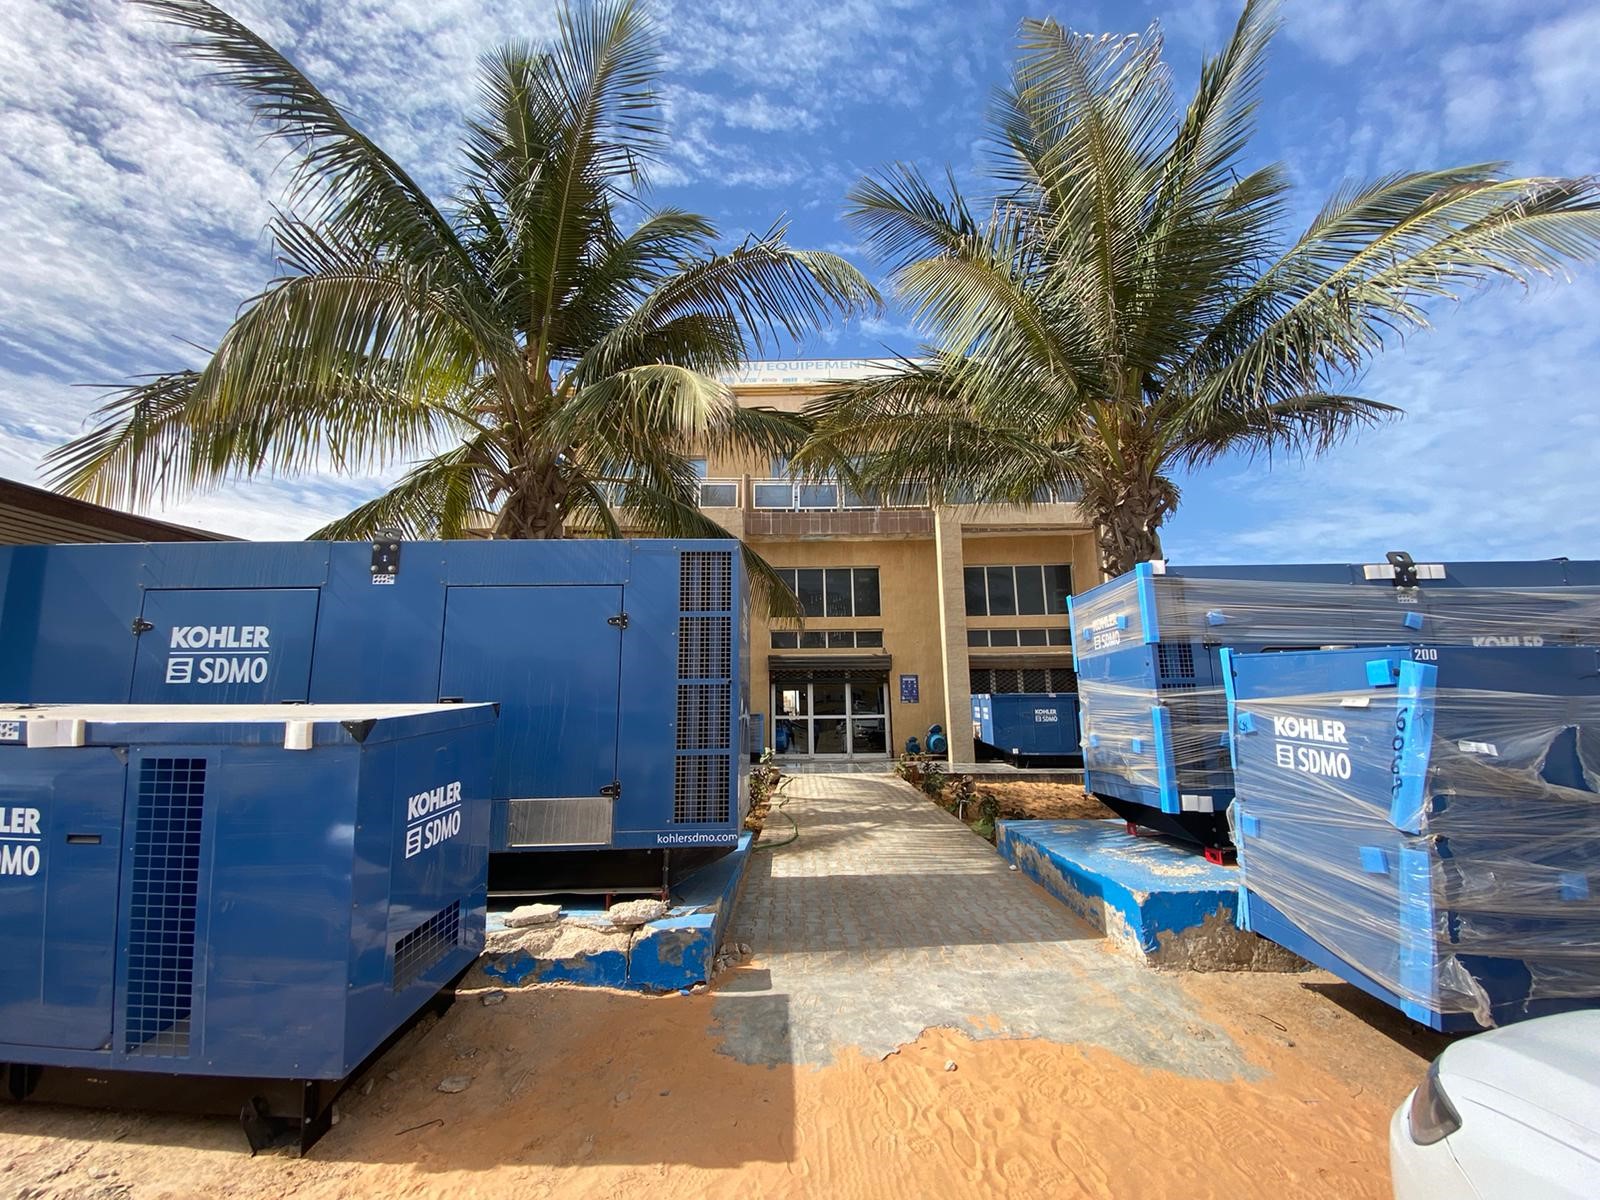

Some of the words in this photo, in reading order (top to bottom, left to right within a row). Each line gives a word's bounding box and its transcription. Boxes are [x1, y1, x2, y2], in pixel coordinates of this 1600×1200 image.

[169, 625, 270, 649] KOHLER
[1414, 648, 1438, 661] 200
[196, 657, 269, 684] SDMO
[1273, 715, 1350, 745] KOHLER
[1297, 746, 1352, 780] SDMO
[407, 781, 462, 821] KOHLER
[423, 810, 461, 850] SDMO
[656, 832, 738, 844] kohlersdmo.com
[0, 844, 41, 876] MO
